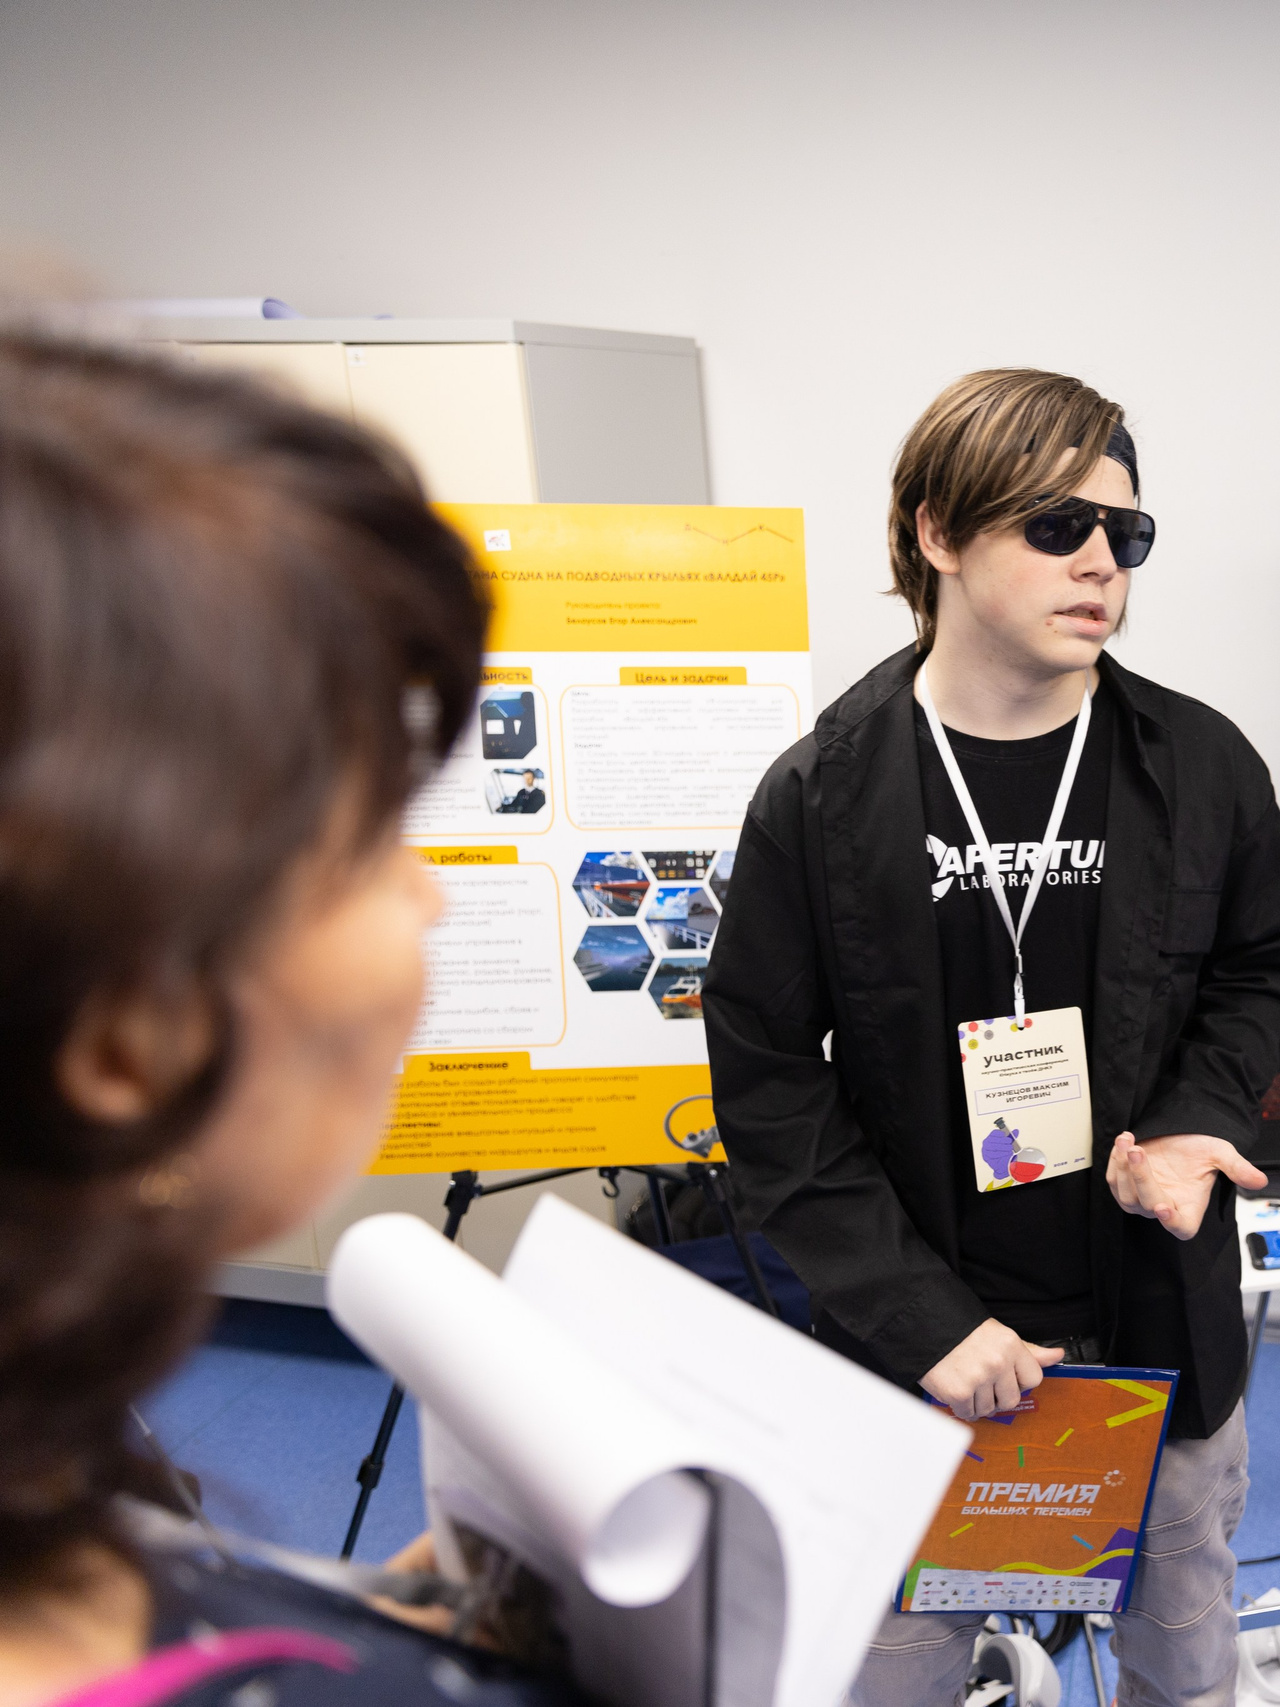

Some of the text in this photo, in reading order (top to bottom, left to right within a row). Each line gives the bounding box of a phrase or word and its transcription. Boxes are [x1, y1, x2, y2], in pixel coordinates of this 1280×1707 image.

[501, 571, 543, 582] СУДНА
[546, 571, 562, 581] НА
[566, 571, 644, 582] ПОДВОДНЫХ
[648, 572, 701, 582] КРЫЛЬЯХ
[634, 672, 729, 684] Цель и задачи
[440, 852, 492, 865] работы
[936, 839, 1106, 879] APERTU
[983, 1044, 1064, 1068] участник
[429, 1061, 508, 1073] Заключение
[985, 1081, 1070, 1099] КУЗНЕЦОВ МАКСИМ
[1006, 1091, 1051, 1103] ИГОРЕВИЧ
[965, 1482, 1102, 1504] ПРЕМИЯ
[961, 1505, 1093, 1517] БОЛЬШИХ ПЕРЕМЕН
